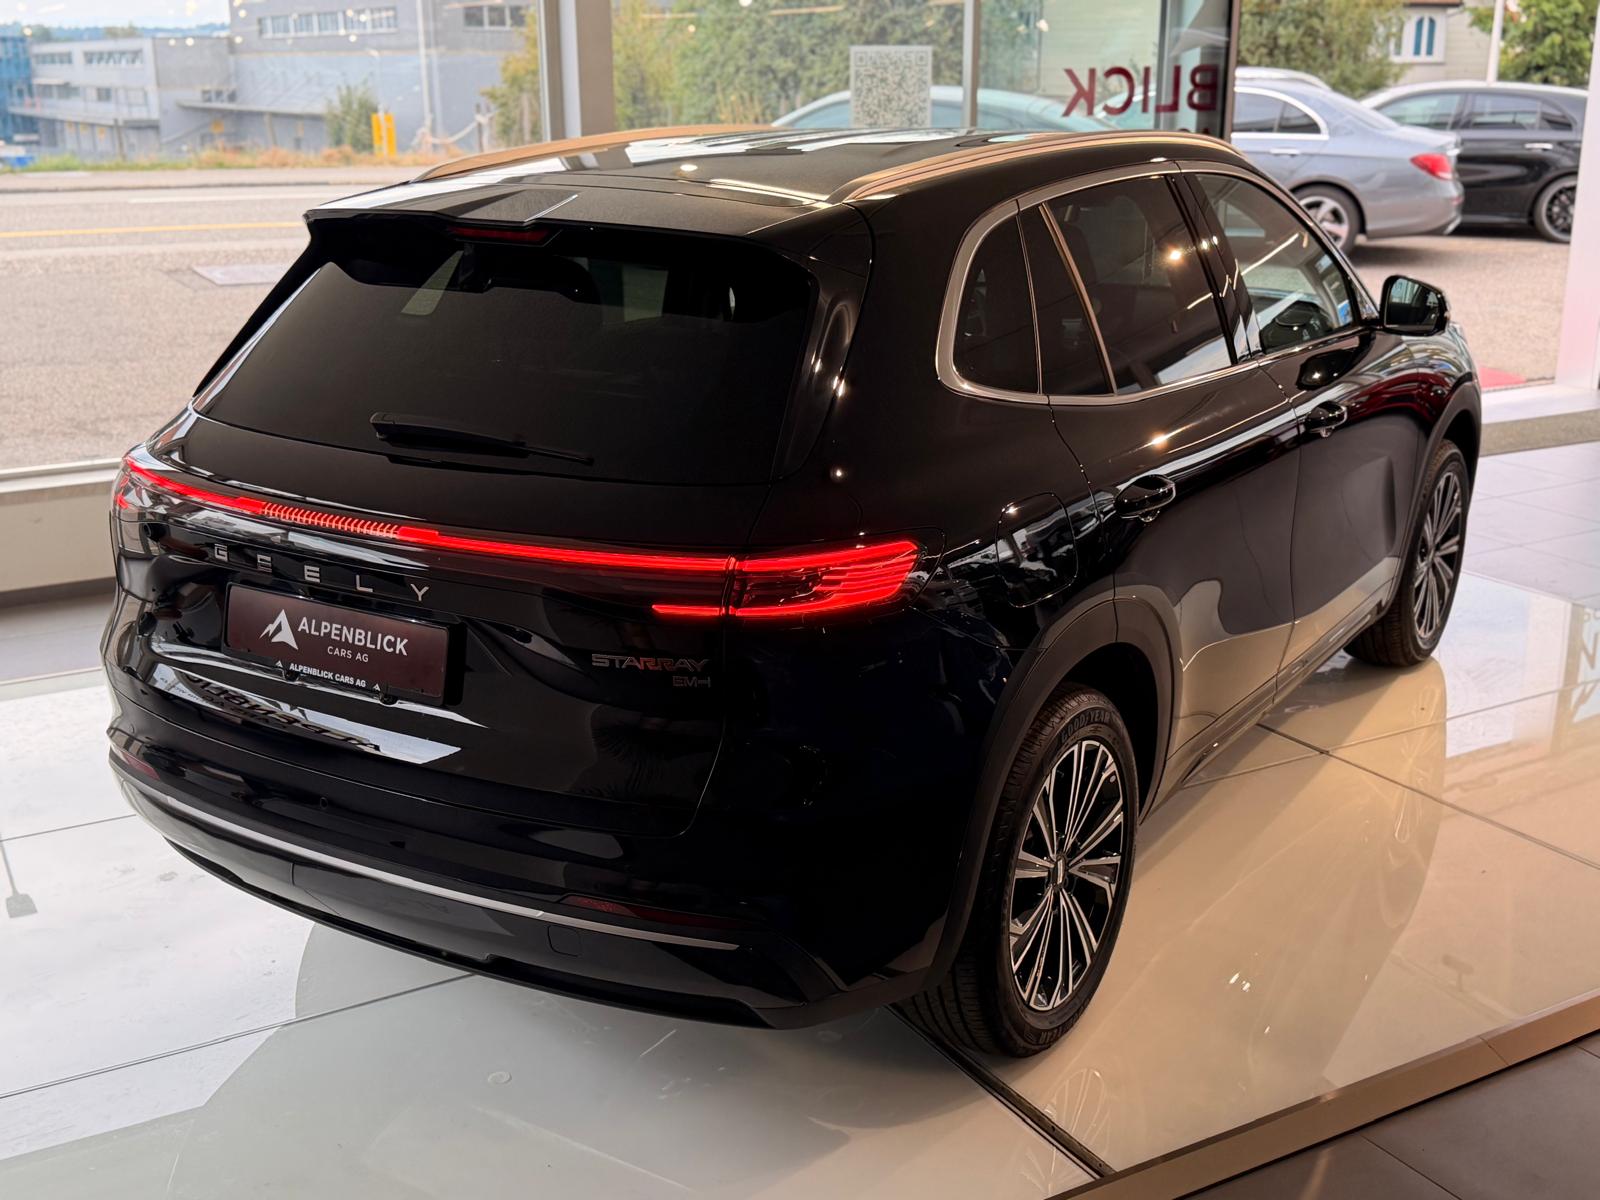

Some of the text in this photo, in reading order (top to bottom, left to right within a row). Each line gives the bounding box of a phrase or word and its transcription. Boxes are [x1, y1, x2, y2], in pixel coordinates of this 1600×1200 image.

[214, 543, 429, 601] GEELY
[298, 616, 409, 656] ALPENBLICK
[327, 646, 369, 663] CARS AG
[591, 653, 709, 672] STARRAY
[289, 662, 367, 688] ALPENBLICK CARS AG
